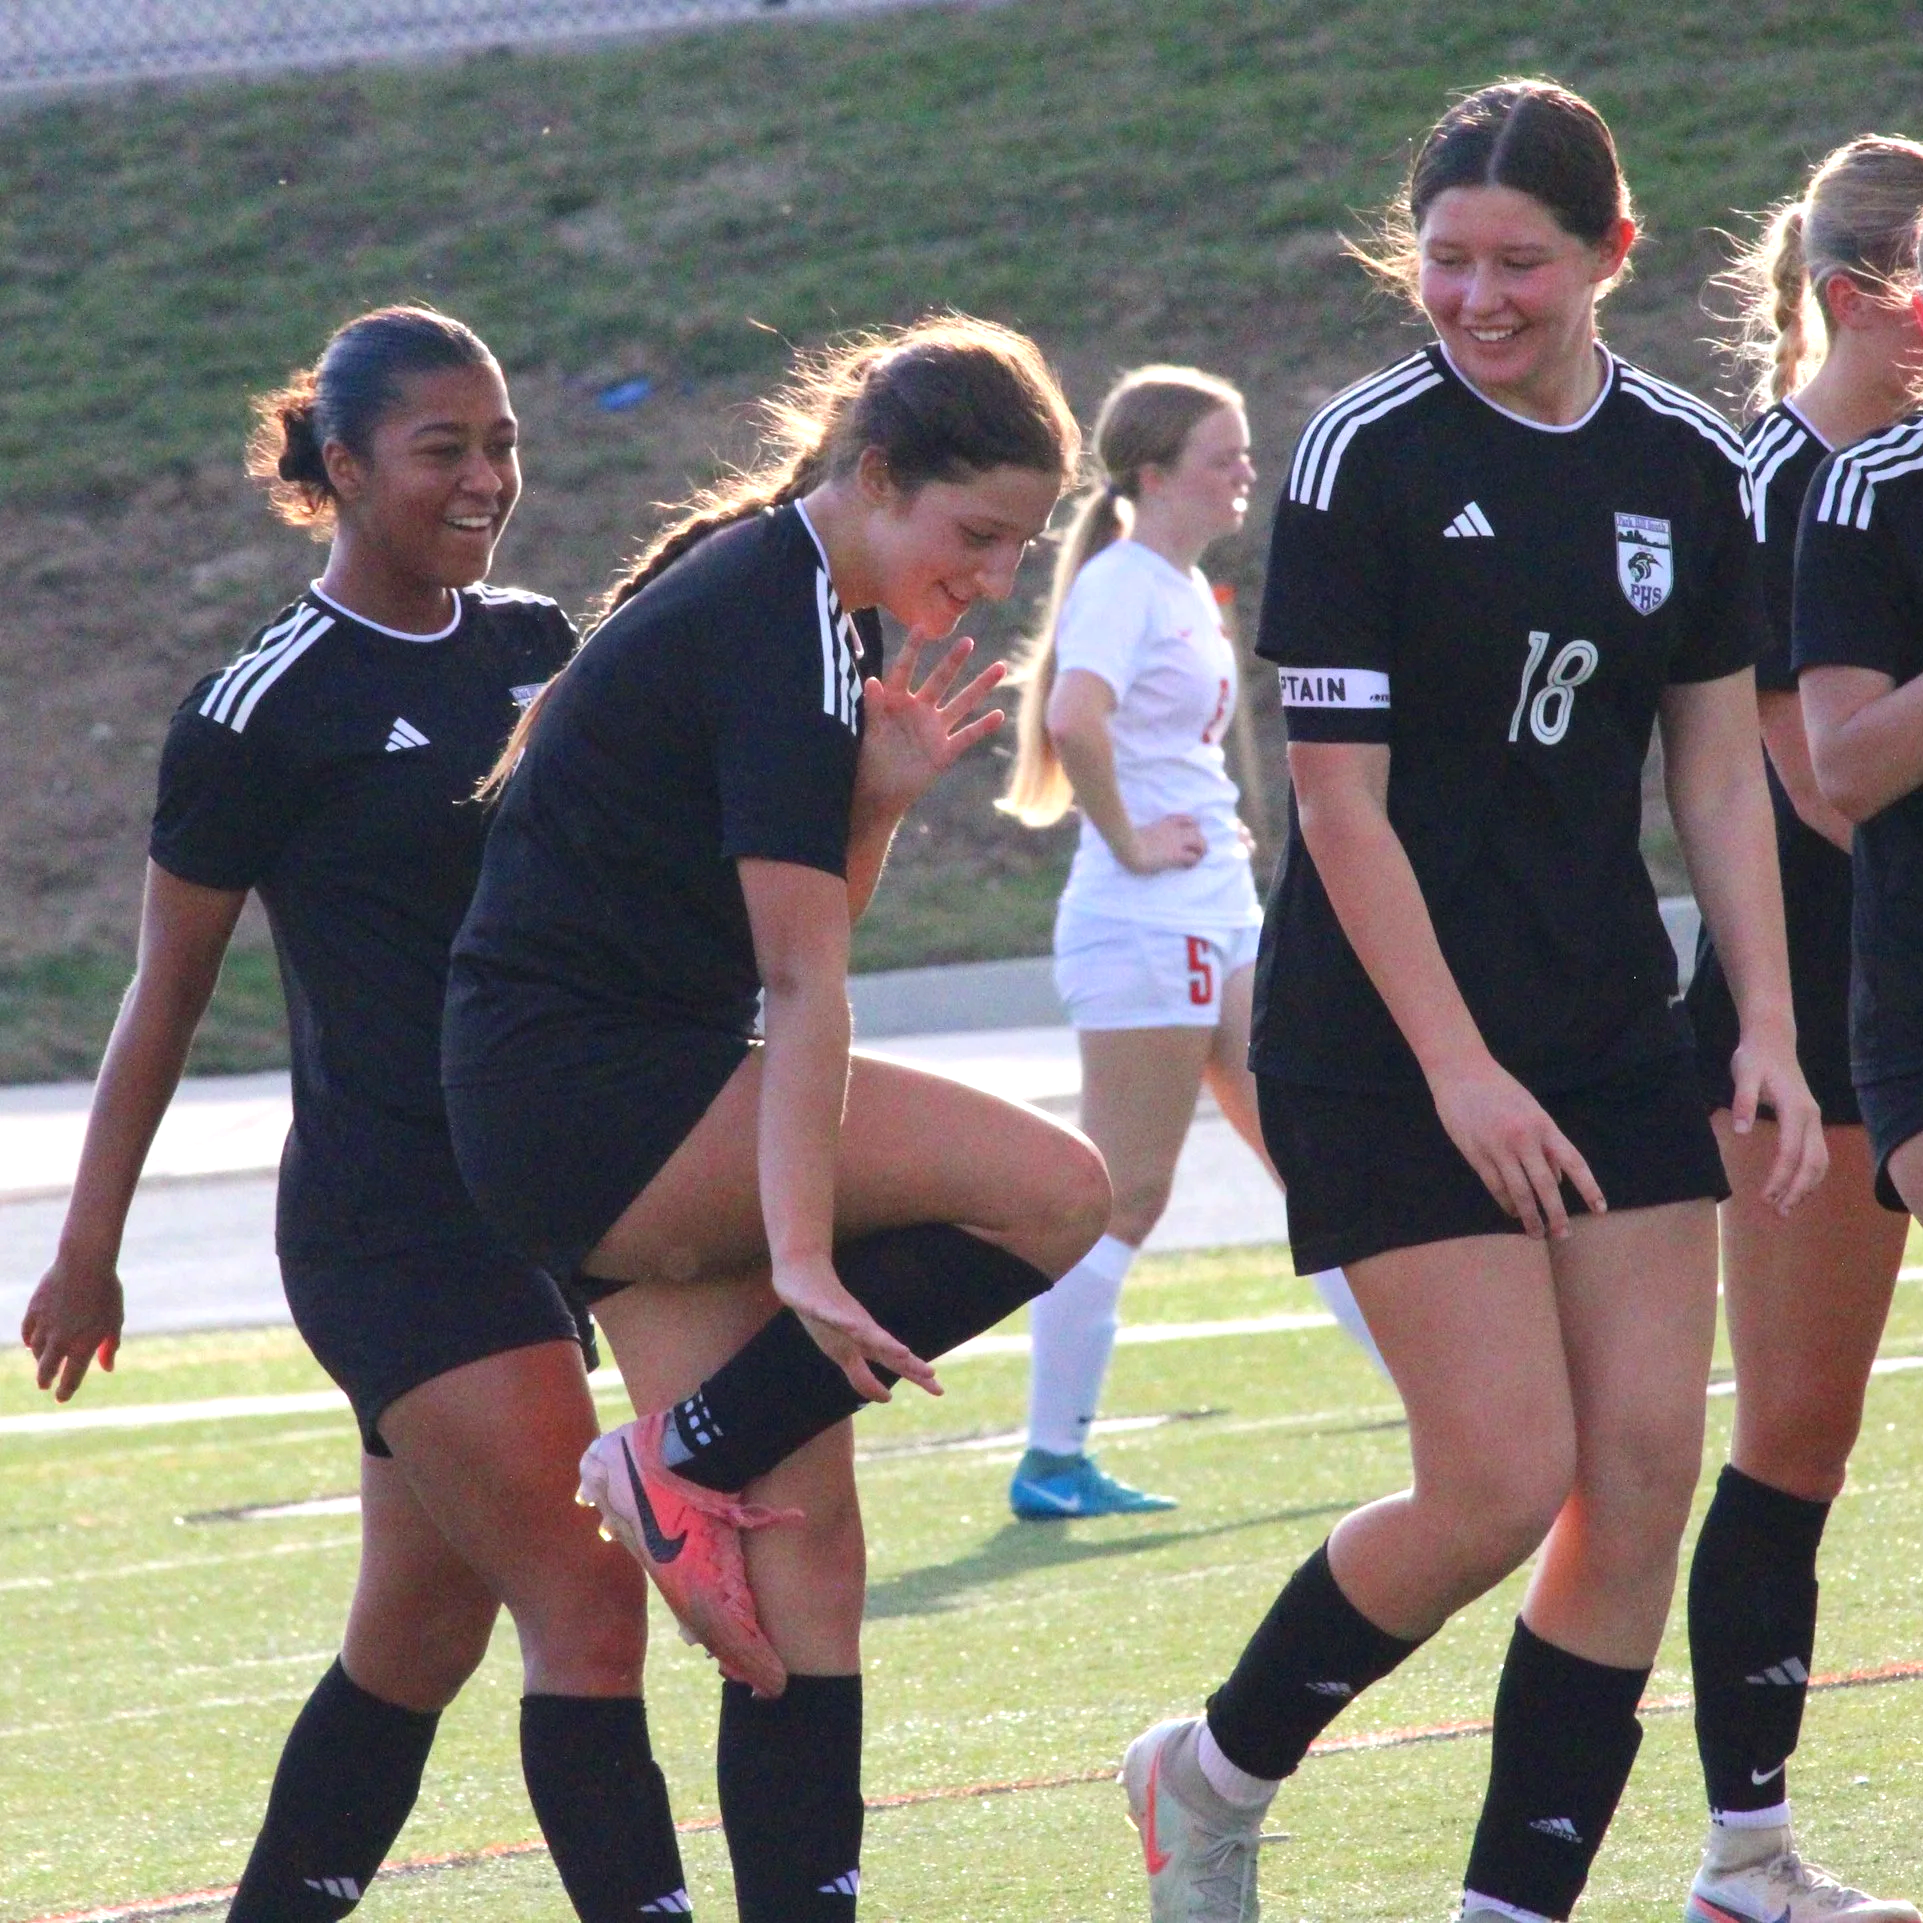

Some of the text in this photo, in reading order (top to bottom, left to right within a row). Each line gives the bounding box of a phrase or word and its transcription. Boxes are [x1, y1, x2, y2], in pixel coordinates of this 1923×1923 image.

[1631, 584, 1662, 610] PHS
[1508, 630, 1598, 745] 18
[1185, 935, 1213, 1005] 5
